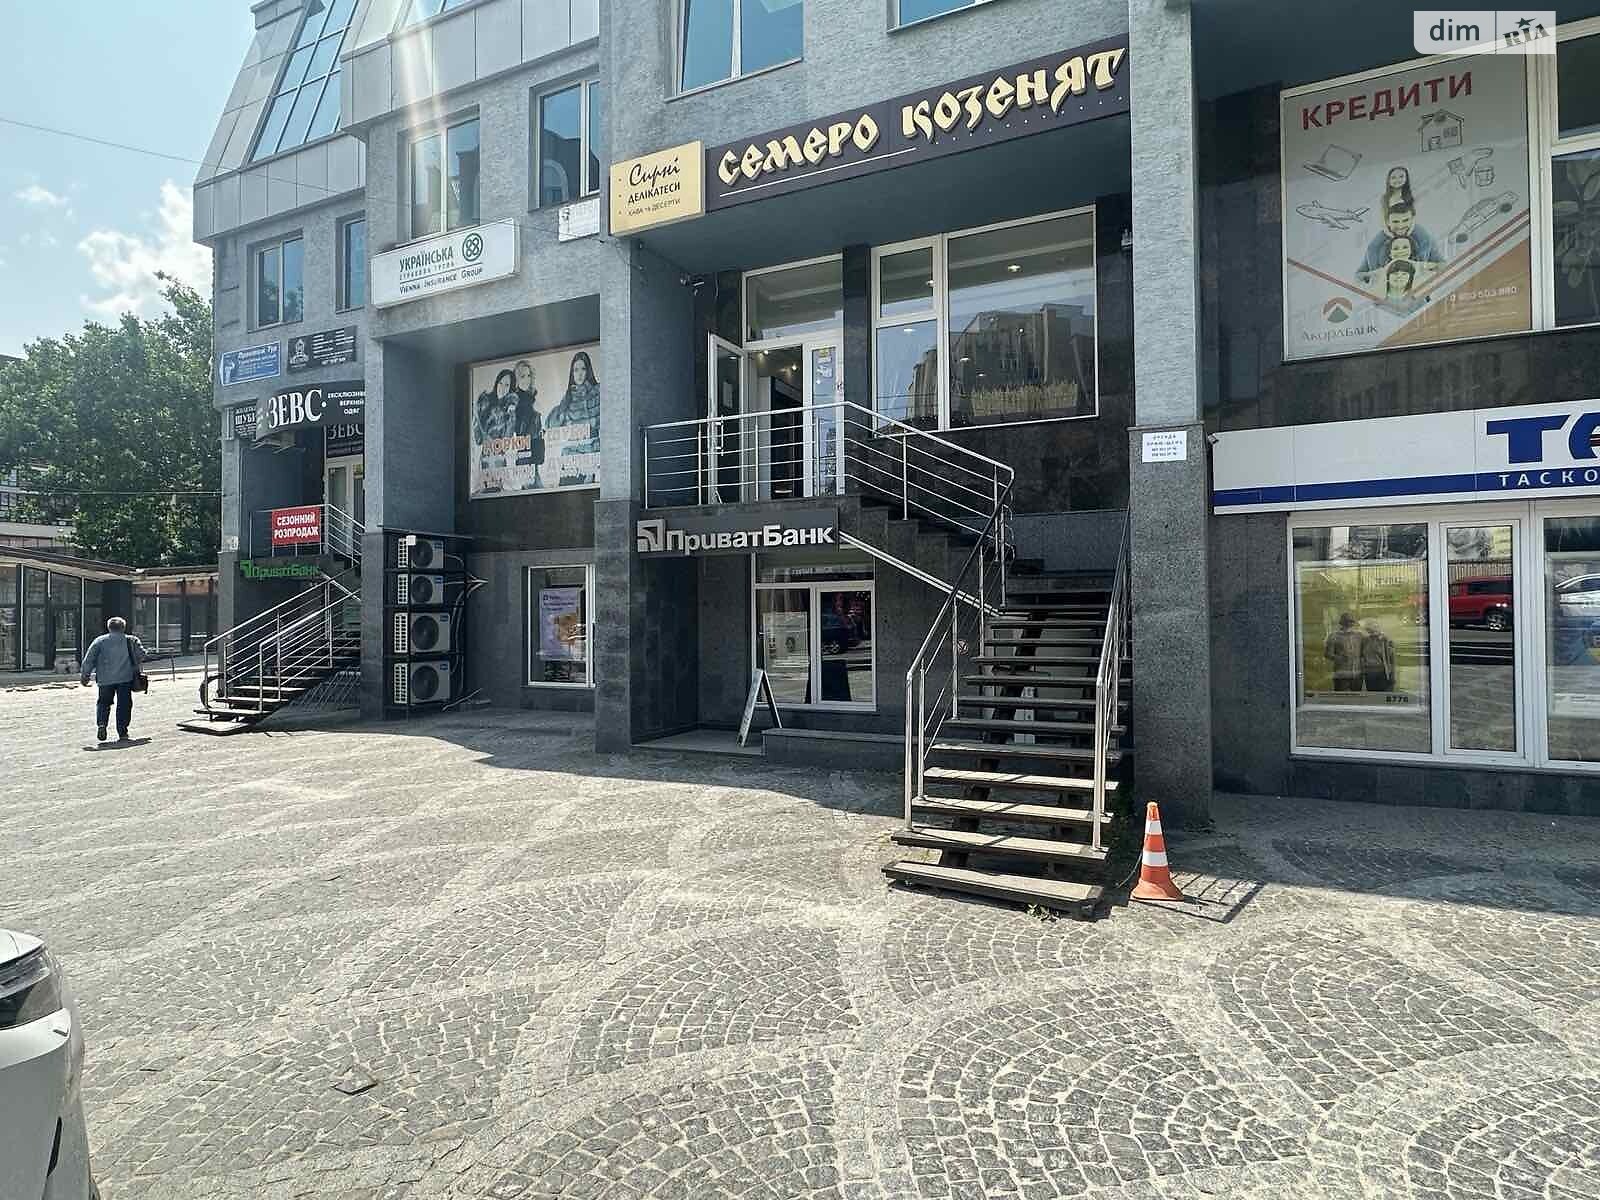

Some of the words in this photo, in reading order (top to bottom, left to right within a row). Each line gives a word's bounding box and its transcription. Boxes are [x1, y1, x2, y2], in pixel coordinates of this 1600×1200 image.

[1302, 71, 1473, 130] КРЕДИТИ
[629, 156, 681, 187] Сирні
[628, 181, 681, 205] ДЕЛІКАТЕСИ
[400, 246, 453, 272] УКРАЇНСЬКА
[268, 389, 322, 429] ЗЕВС
[1498, 469, 1599, 488] ТАСКО
[277, 511, 316, 526] СЕЗОННИЙ
[274, 526, 319, 539] РОЗПРОДАЖ
[666, 524, 835, 556] ПриватБанк
